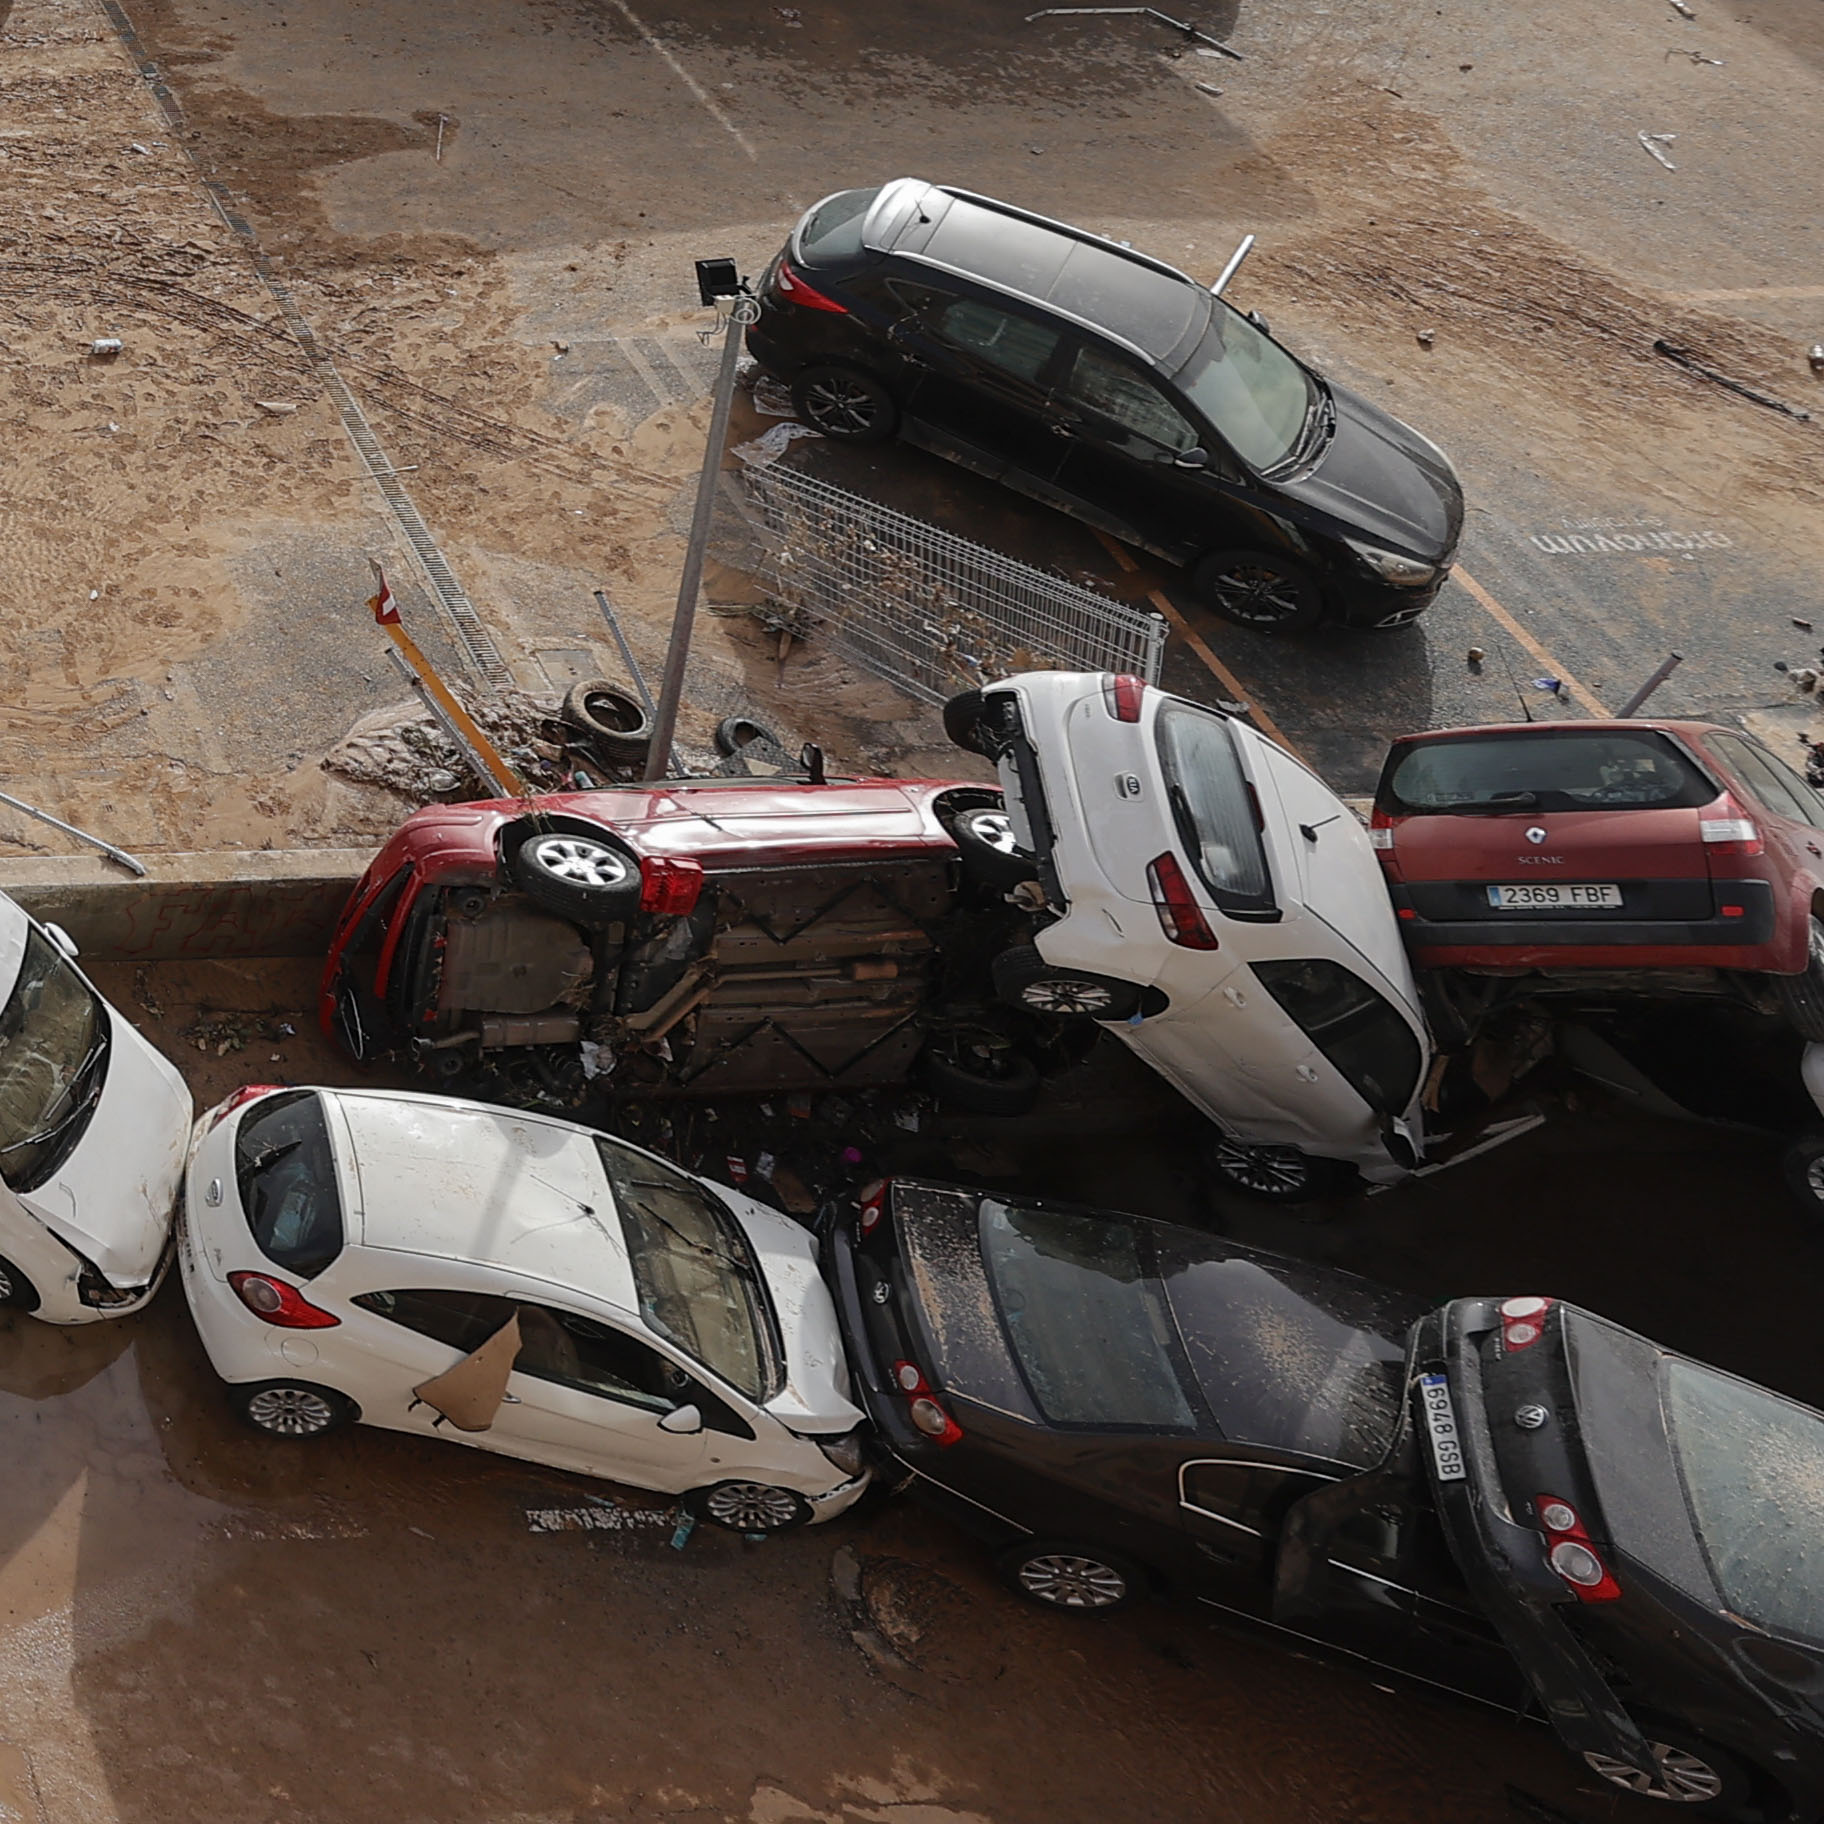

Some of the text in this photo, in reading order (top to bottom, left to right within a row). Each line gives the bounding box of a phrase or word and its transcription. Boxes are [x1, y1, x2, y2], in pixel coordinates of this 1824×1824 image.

[1517, 856, 1565, 865] SCENIC
[1504, 886, 1612, 904] 2369 FBF
[1426, 1387, 1461, 1475] 6948 GSB
